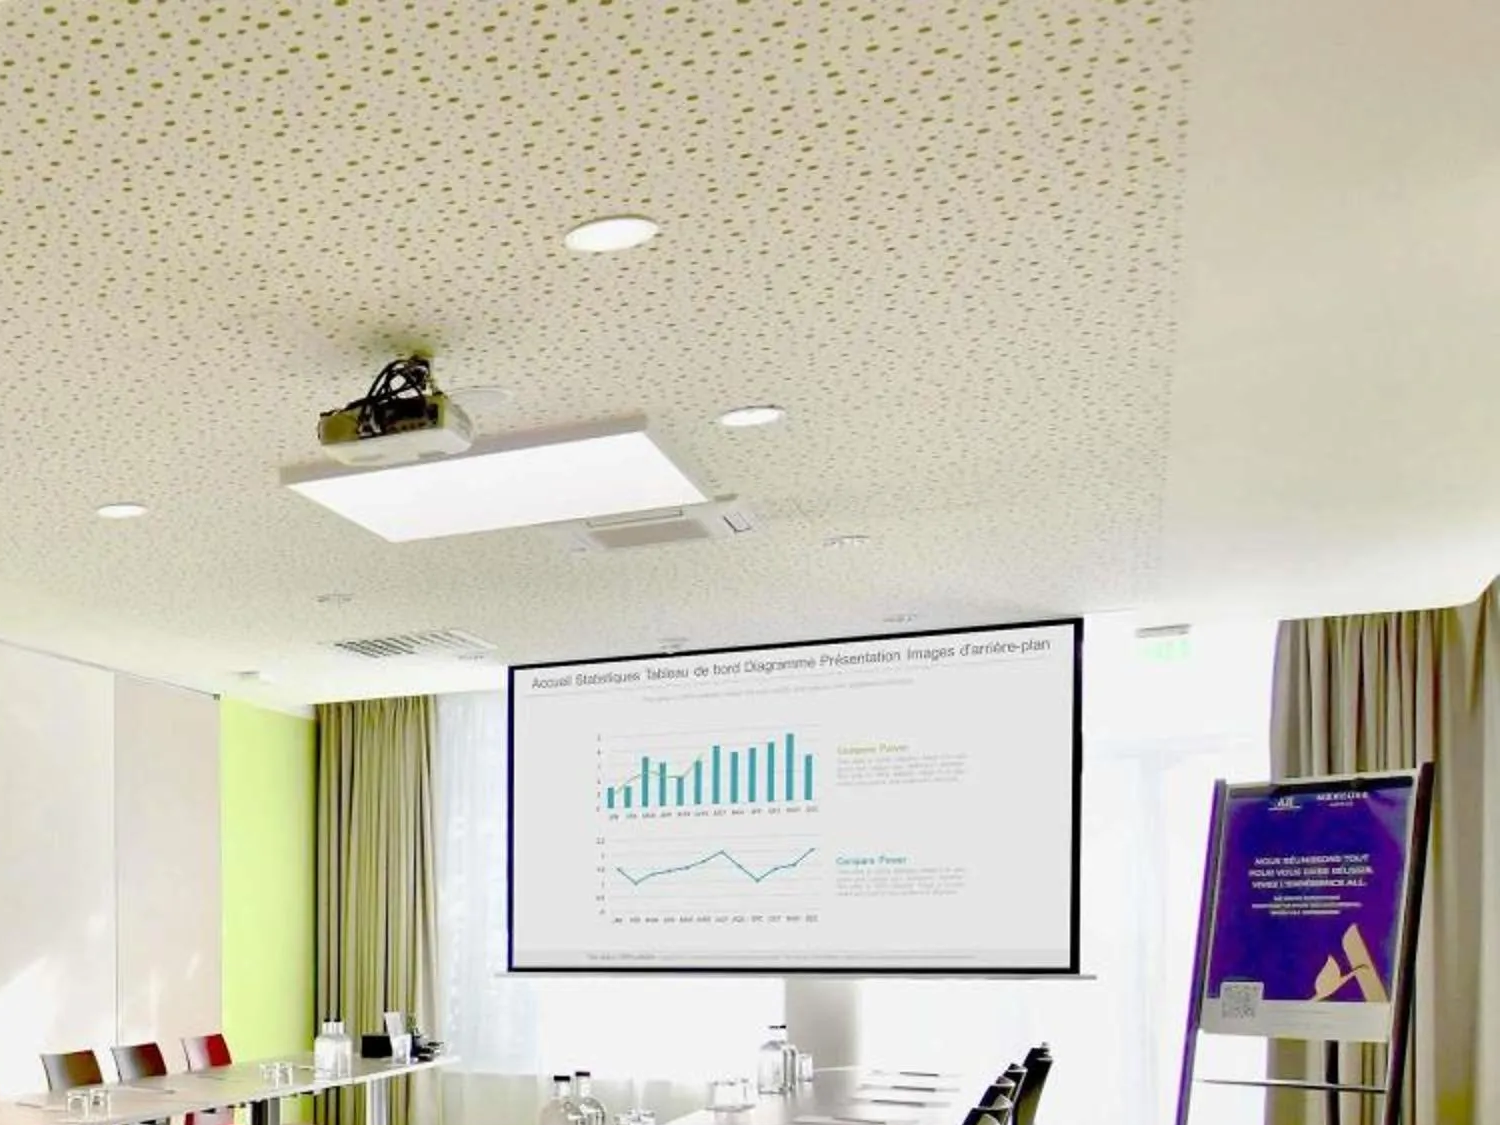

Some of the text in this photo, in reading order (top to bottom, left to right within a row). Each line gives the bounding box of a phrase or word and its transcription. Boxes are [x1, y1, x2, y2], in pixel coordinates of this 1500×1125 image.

[532, 675, 572, 689] Accueil
[576, 671, 641, 687] Statistiques
[647, 667, 689, 681] Tableau
[694, 665, 709, 677] de
[713, 662, 741, 675] bord
[744, 658, 816, 674] Diagramme
[820, 649, 901, 667] Présentation
[907, 645, 955, 662] Images
